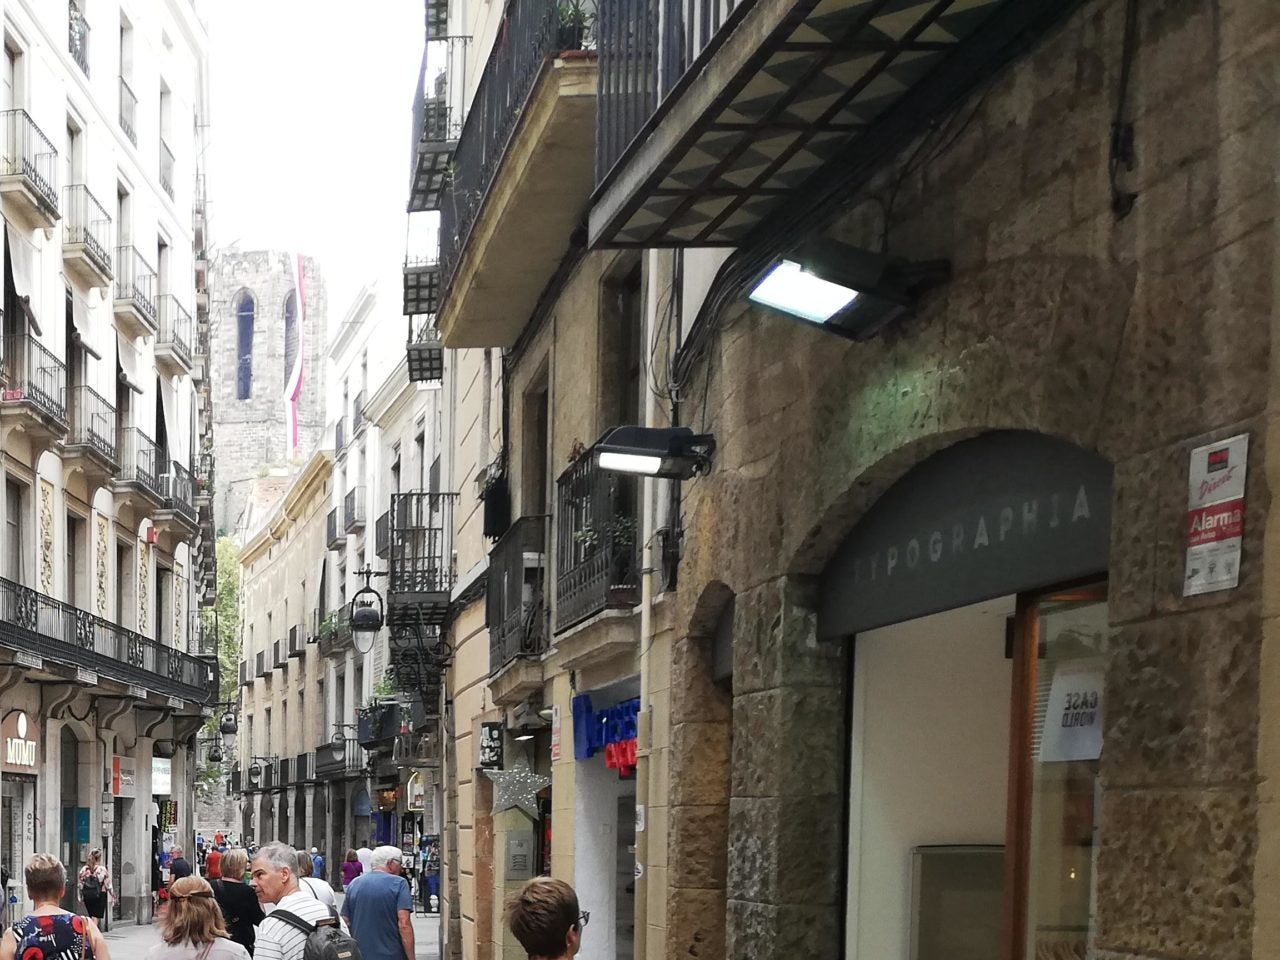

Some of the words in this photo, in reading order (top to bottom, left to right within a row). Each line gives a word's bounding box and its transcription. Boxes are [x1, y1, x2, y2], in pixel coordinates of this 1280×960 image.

[854, 484, 1091, 585] TYPOGRAPHIA
[1190, 508, 1242, 533] Alarma
[6, 737, 37, 767] MUMU
